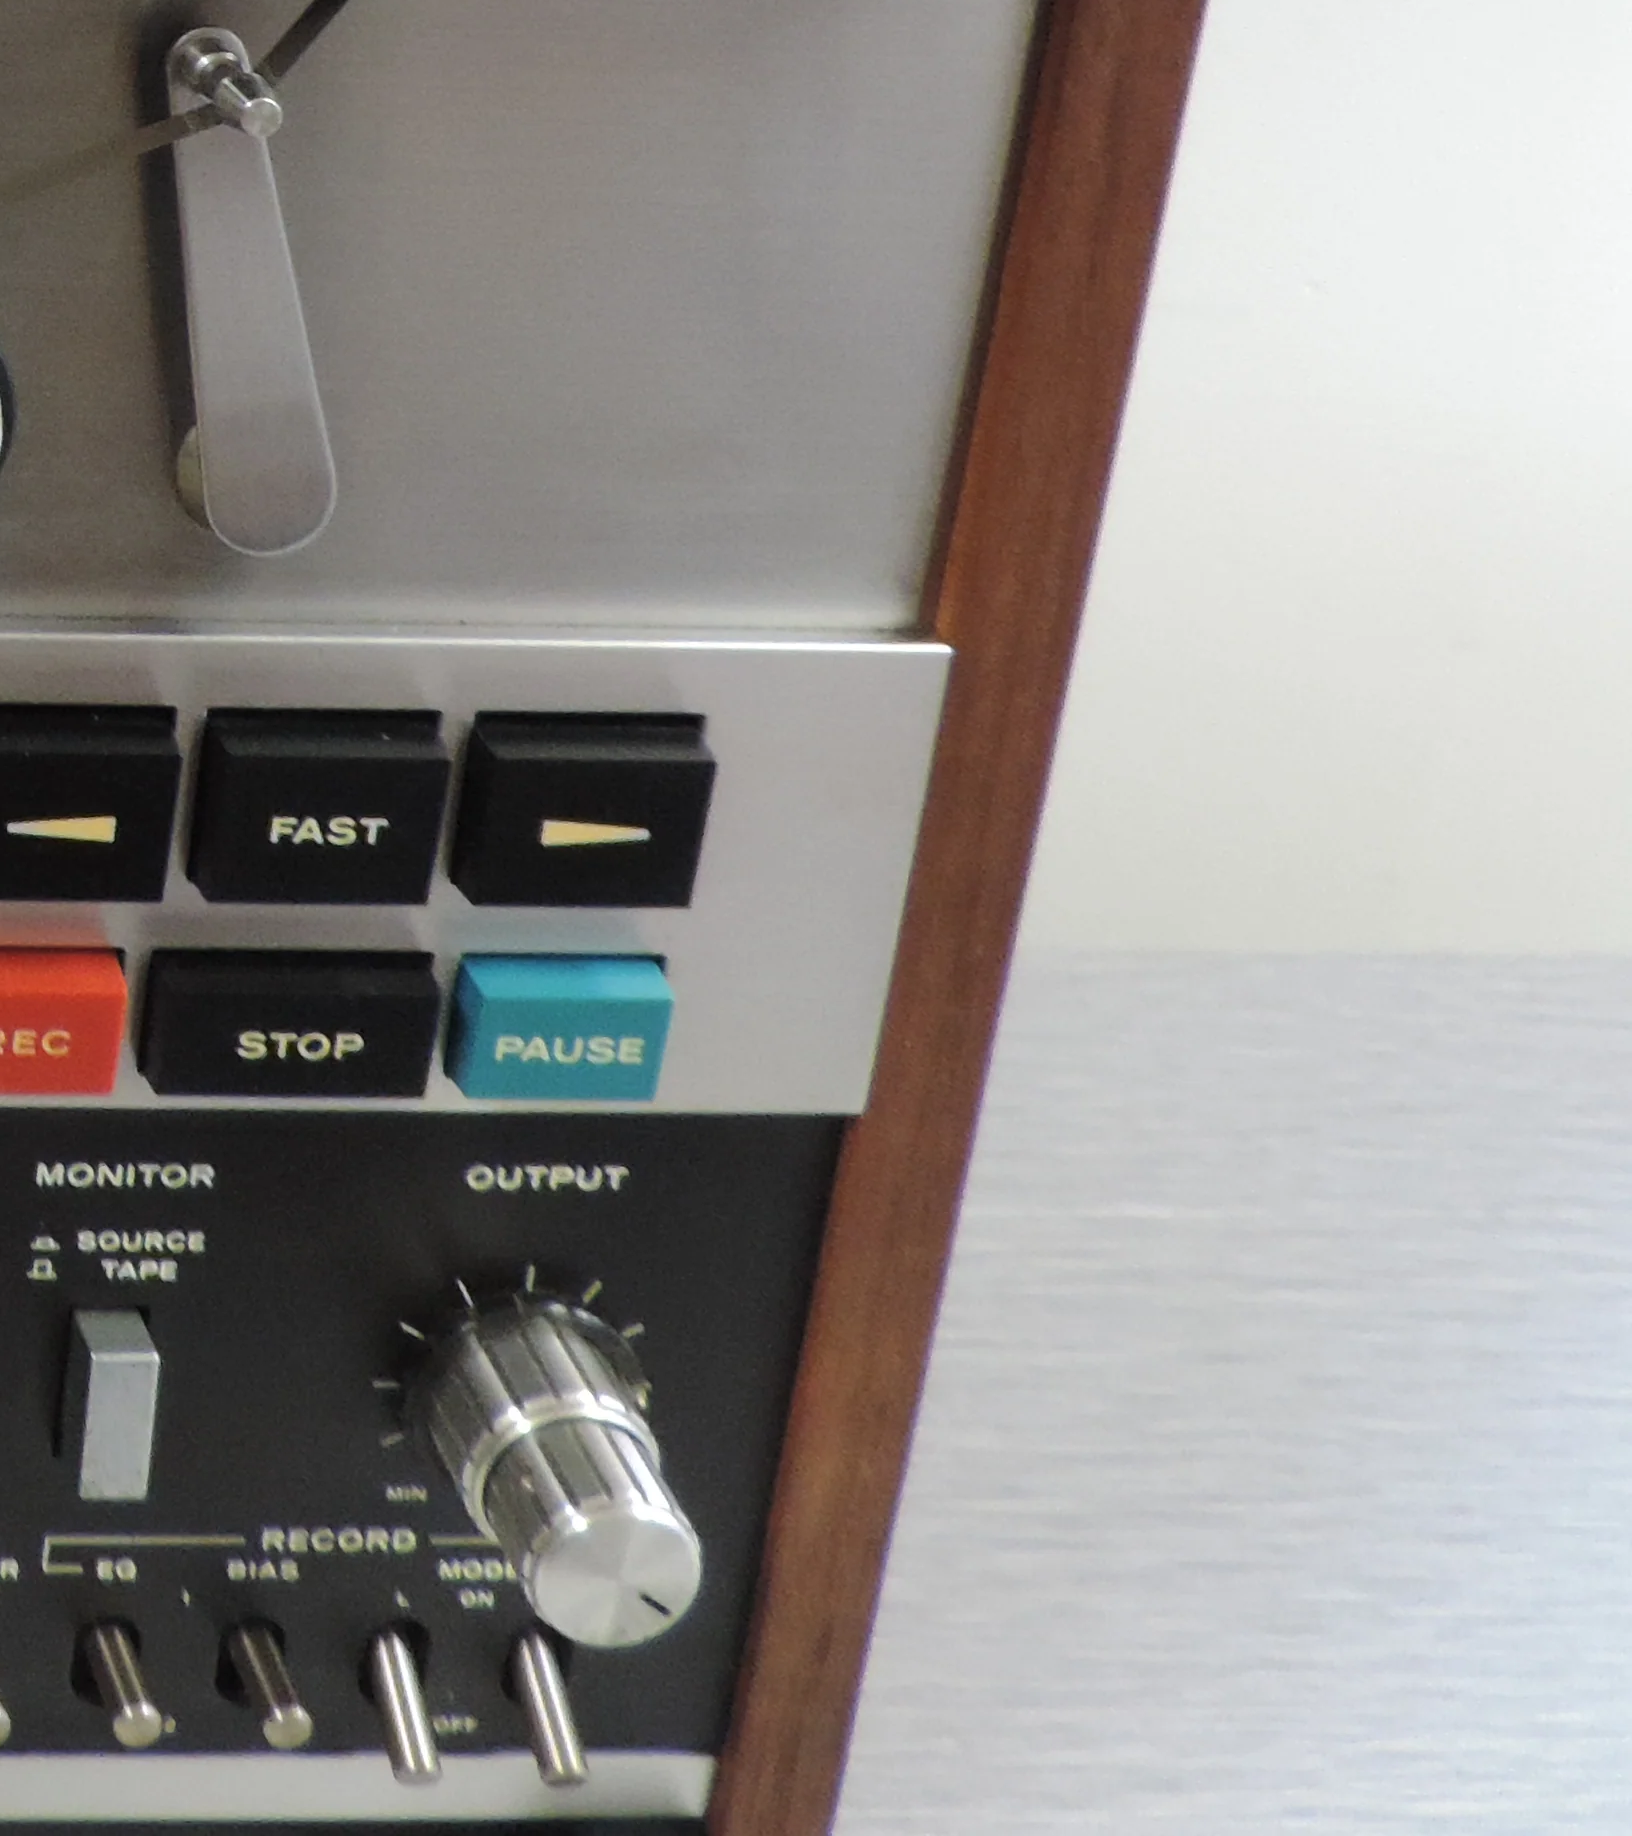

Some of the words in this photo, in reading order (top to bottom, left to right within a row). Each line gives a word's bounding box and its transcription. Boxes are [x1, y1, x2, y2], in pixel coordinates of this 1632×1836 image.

[269, 816, 390, 846] FAST
[236, 1031, 365, 1062] STOP
[494, 1034, 645, 1065] PAUSE
[36, 1162, 216, 1189] MONITOR
[466, 1164, 630, 1192] OUTPUT
[76, 1230, 206, 1254] SOURCE
[100, 1259, 178, 1282] TAPE
[385, 1483, 428, 1502] MIN
[261, 1526, 417, 1553] RECORD
